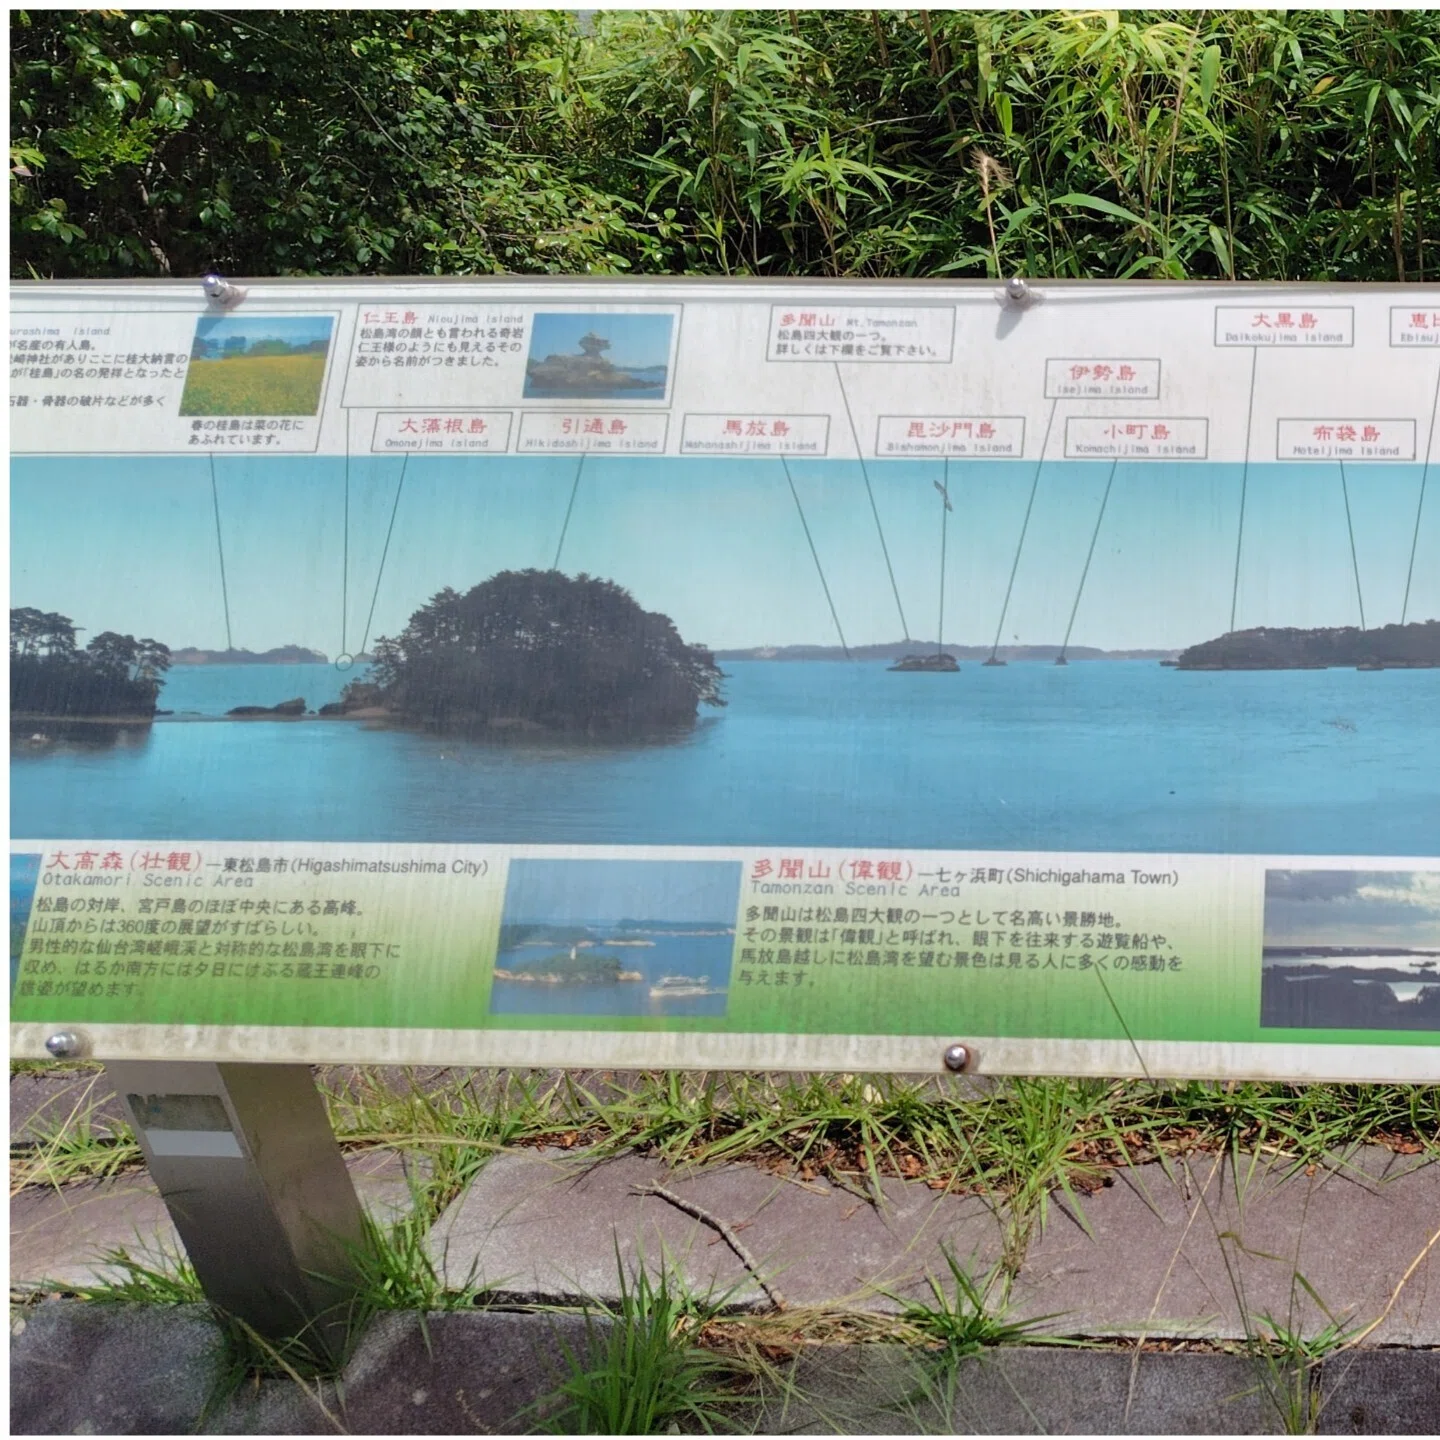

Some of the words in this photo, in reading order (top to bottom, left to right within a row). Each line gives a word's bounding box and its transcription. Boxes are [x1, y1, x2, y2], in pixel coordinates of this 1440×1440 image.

[364, 311, 418, 326] 仁王島
[780, 313, 836, 328] 多聞山
[1251, 311, 1318, 329] 大黒島
[360, 327, 524, 341] 松島湾の顔とも言われる奇岩
[778, 330, 888, 342] 松島四大観の一つ。
[358, 341, 522, 354] 仁王様のようにも見えるその
[776, 343, 937, 356] 詳しくは下欄をご覧下さい。
[355, 355, 500, 368] 姿から名前がつきました。
[1069, 365, 1136, 381] 伊勢島
[561, 418, 628, 435] 引通島
[723, 420, 790, 437] 馬放島
[908, 421, 996, 439] 毘沙門島
[1104, 424, 1170, 441] 小町島
[1313, 425, 1380, 442] 布袋島
[42, 872, 132, 888] Otakamori
[143, 873, 204, 888] Scenic
[213, 874, 254, 889] Area
[751, 881, 834, 895] Tamonzan
[845, 883, 908, 897] Scenic
[919, 884, 960, 898] Area
[745, 905, 1124, 929] 多聞山は松島四大観の一つとして名高い景勝地。
[740, 949, 1182, 972] 馬放島越しに松島湾を望む景色は見る人に多くの感動を
[738, 970, 816, 988] 与えます。
